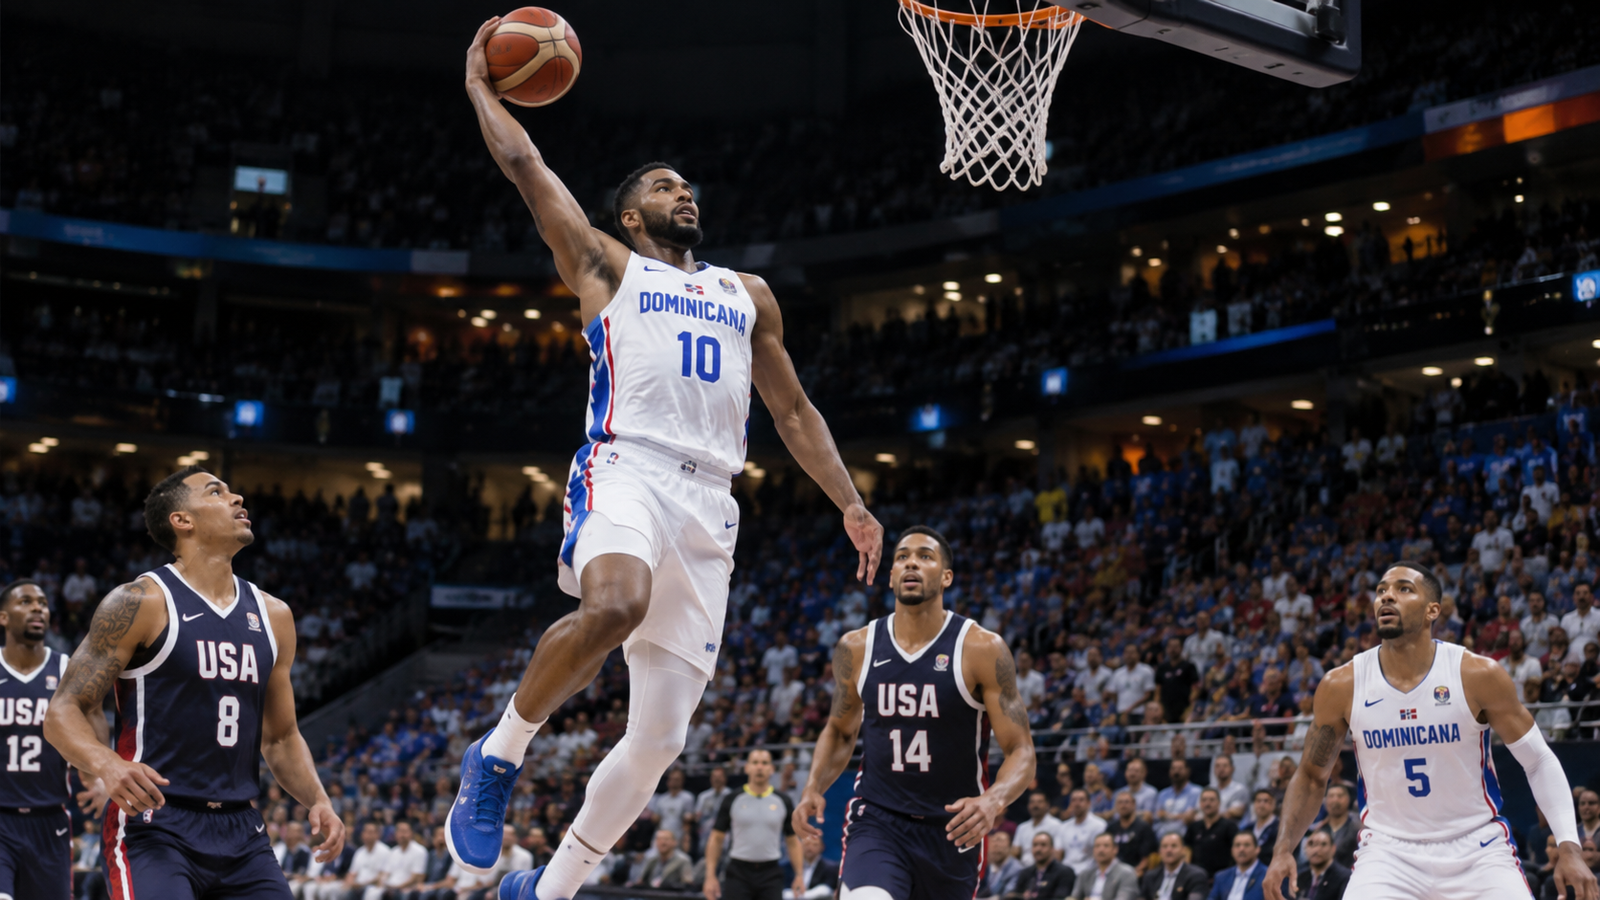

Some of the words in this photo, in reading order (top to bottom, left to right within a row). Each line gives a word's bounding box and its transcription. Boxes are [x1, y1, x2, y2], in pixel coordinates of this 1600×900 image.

[639, 291, 747, 337] DOMINICANA
[677, 330, 722, 384] 10
[196, 639, 260, 685] USA
[0, 697, 49, 726] USA
[216, 695, 240, 748] 8
[877, 683, 940, 718] USA
[6, 734, 42, 772] 12
[889, 728, 932, 772] 14
[1362, 722, 1462, 750] DOMINICANA
[1403, 757, 1432, 798] 5
